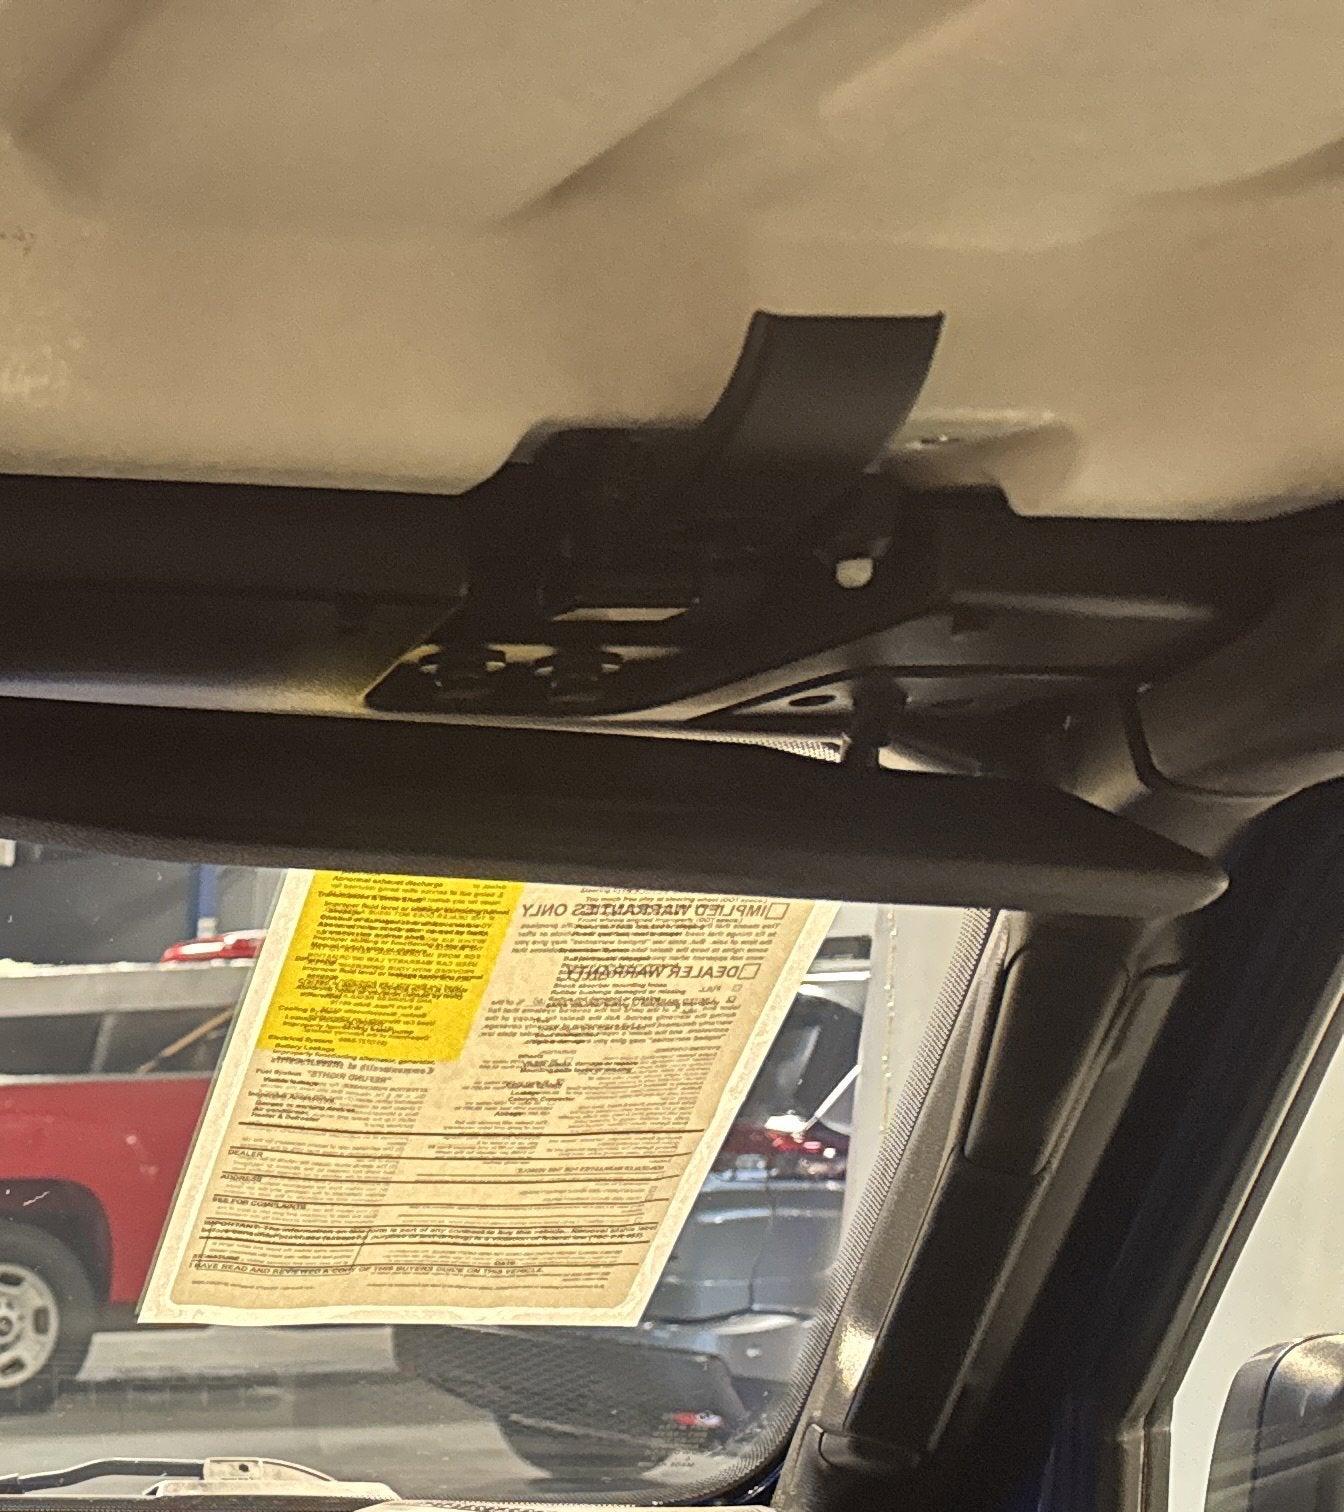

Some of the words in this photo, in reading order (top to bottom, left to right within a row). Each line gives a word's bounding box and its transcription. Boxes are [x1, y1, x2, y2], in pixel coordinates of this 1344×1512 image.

[228, 1150, 264, 1159] DEALER
[220, 1173, 262, 1183] ADDRESS
[221, 1263, 247, 1272] READ
[249, 1265, 271, 1273] AND
